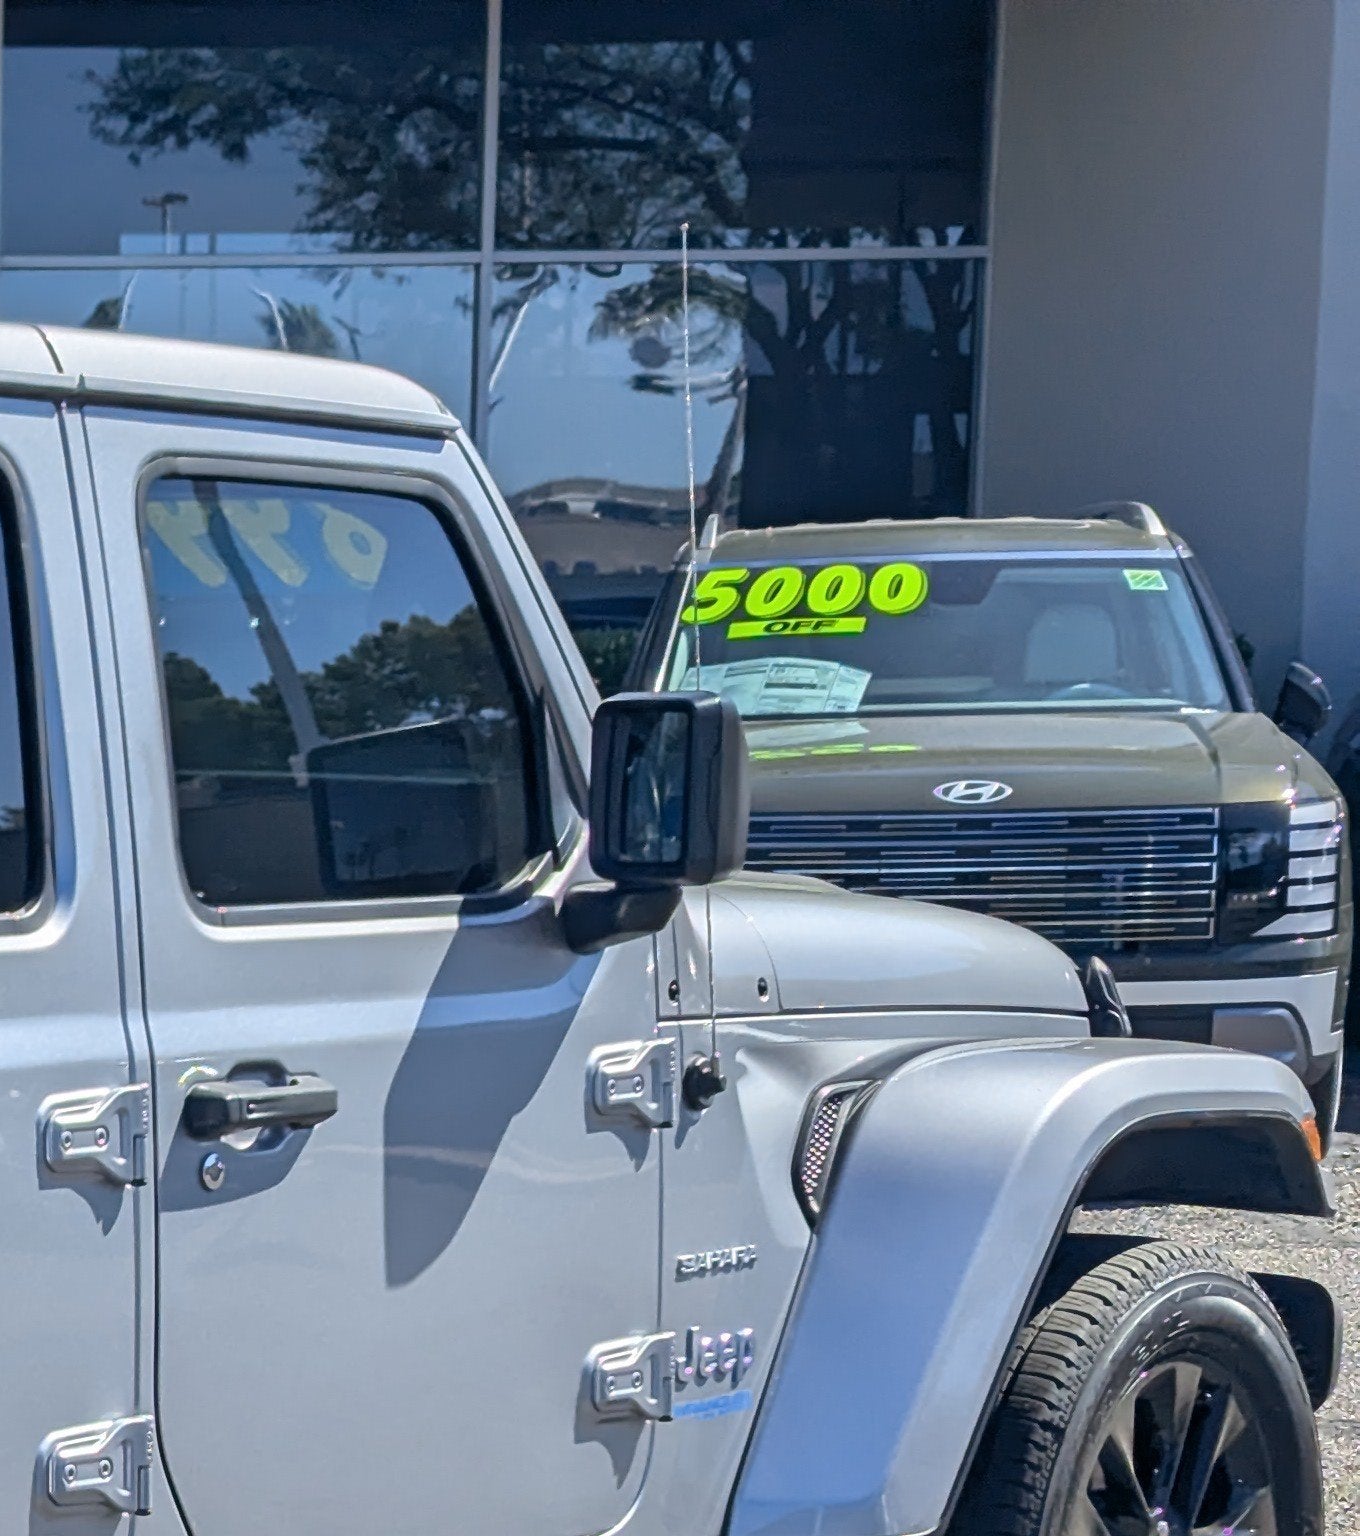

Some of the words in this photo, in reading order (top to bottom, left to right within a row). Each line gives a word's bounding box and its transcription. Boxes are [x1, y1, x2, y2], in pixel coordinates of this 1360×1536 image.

[680, 561, 929, 624] 5000
[763, 619, 838, 634] OFF
[674, 1325, 754, 1385] Jeep
